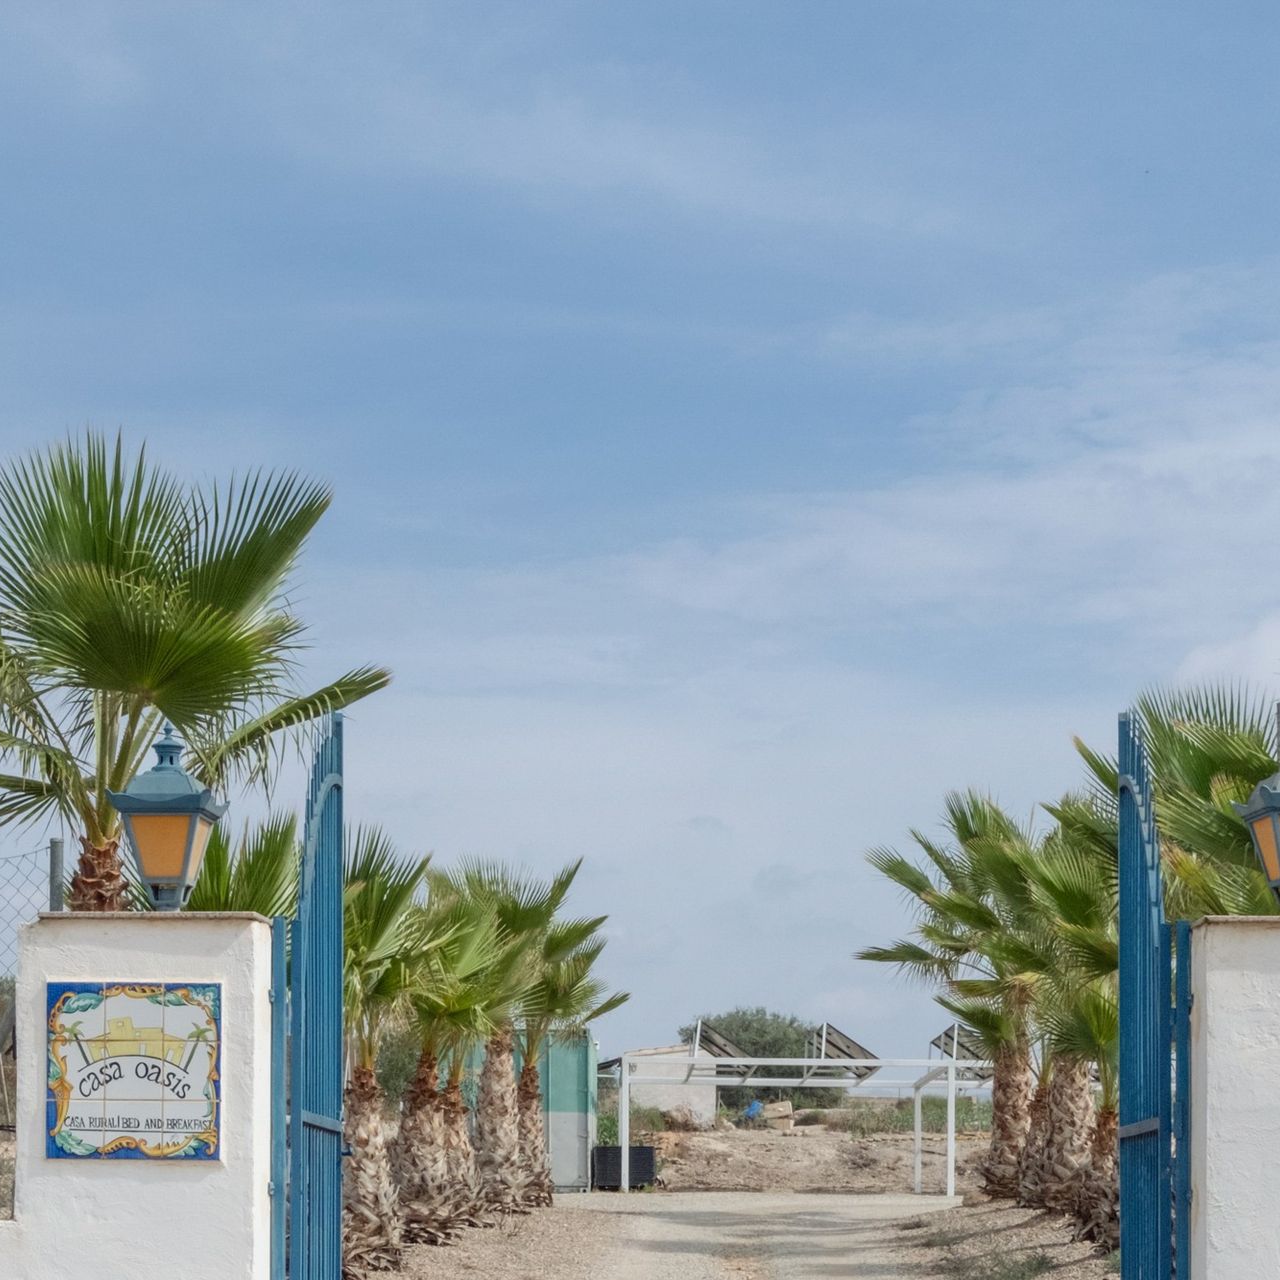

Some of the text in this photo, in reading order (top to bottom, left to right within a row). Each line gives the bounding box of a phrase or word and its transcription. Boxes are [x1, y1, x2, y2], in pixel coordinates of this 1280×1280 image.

[64, 1115, 86, 1128] CASA
[144, 1117, 164, 1129] AND
[166, 1118, 213, 1131] BREAKFAST
